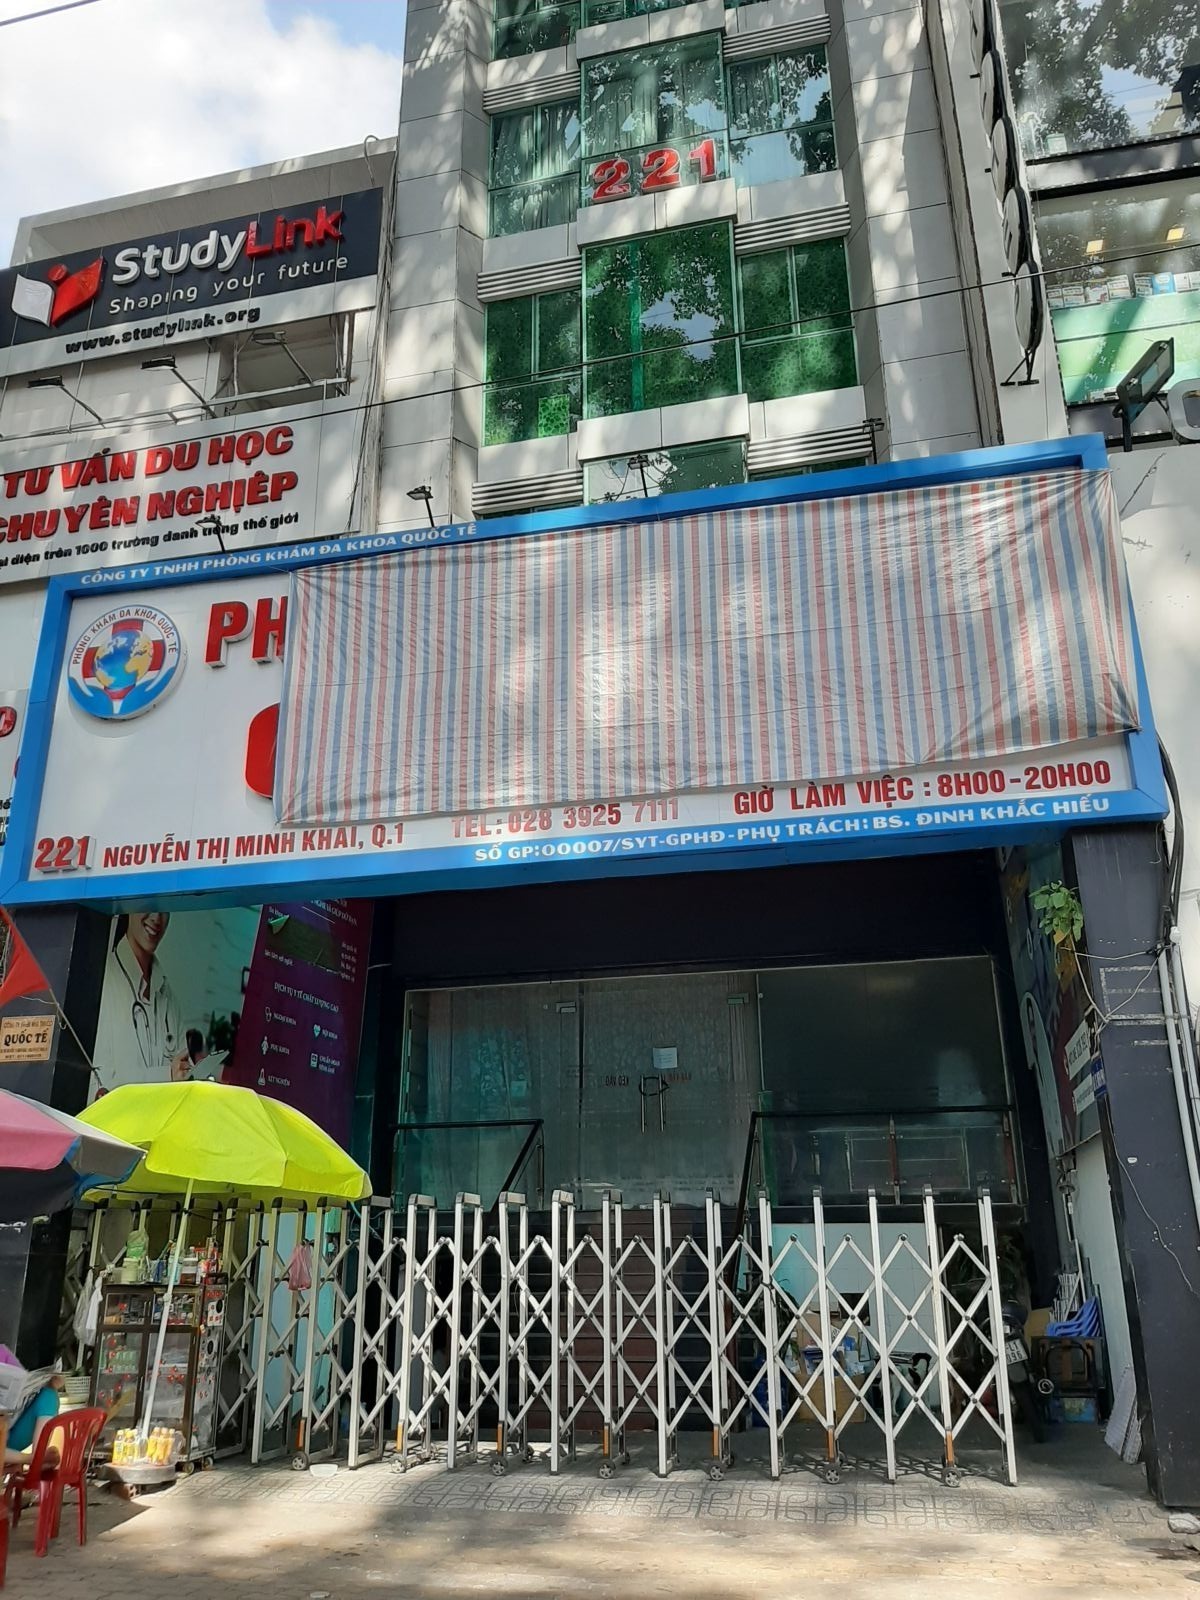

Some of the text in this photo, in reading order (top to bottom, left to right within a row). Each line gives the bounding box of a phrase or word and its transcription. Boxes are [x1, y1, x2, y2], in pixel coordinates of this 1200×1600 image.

[592, 138, 717, 204] 221
[111, 204, 346, 286] StudyLink
[109, 255, 349, 314] Shaping your future
[65, 304, 261, 354] www.studylink.org
[61, 447, 138, 490] VẤN
[145, 440, 200, 478] DU
[207, 425, 295, 467] HỌC
[147, 470, 299, 521] NGHIỆP
[11, 552, 41, 566] diện
[44, 547, 73, 561] trên
[75, 541, 109, 556] 1000
[111, 534, 160, 551] trường
[163, 527, 198, 543] danh
[243, 515, 269, 531] thế
[270, 511, 299, 530] giới
[81, 569, 126, 585] CÔNG
[130, 566, 150, 580] TY
[153, 561, 199, 577] TNHH
[202, 552, 262, 570] PHÒNG
[265, 545, 316, 562] KHÁM
[318, 542, 342, 556] ĐA
[347, 535, 397, 552] KHOA
[401, 525, 452, 545] QUỐC
[134, 608, 157, 622] KHOA
[733, 786, 775, 816] GIỜ
[788, 780, 845, 811] LÀM
[856, 774, 914, 809] VIỆC
[34, 835, 93, 872] 221
[103, 832, 191, 868] NGUYỄN
[196, 836, 230, 864] THỊ
[235, 831, 296, 858] MINH
[302, 825, 364, 852] KHAI,
[371, 822, 404, 848] Q.1
[507, 807, 554, 833] 028
[563, 802, 623, 829] 3925
[630, 797, 679, 823] 7111
[474, 841, 505, 862] SỐ
[916, 808, 975, 826] ĐINH
[980, 798, 1047, 821] KHẮC
[1052, 793, 1110, 815] HIẾU
[4, 1027, 49, 1046] QUỐC TẾ
